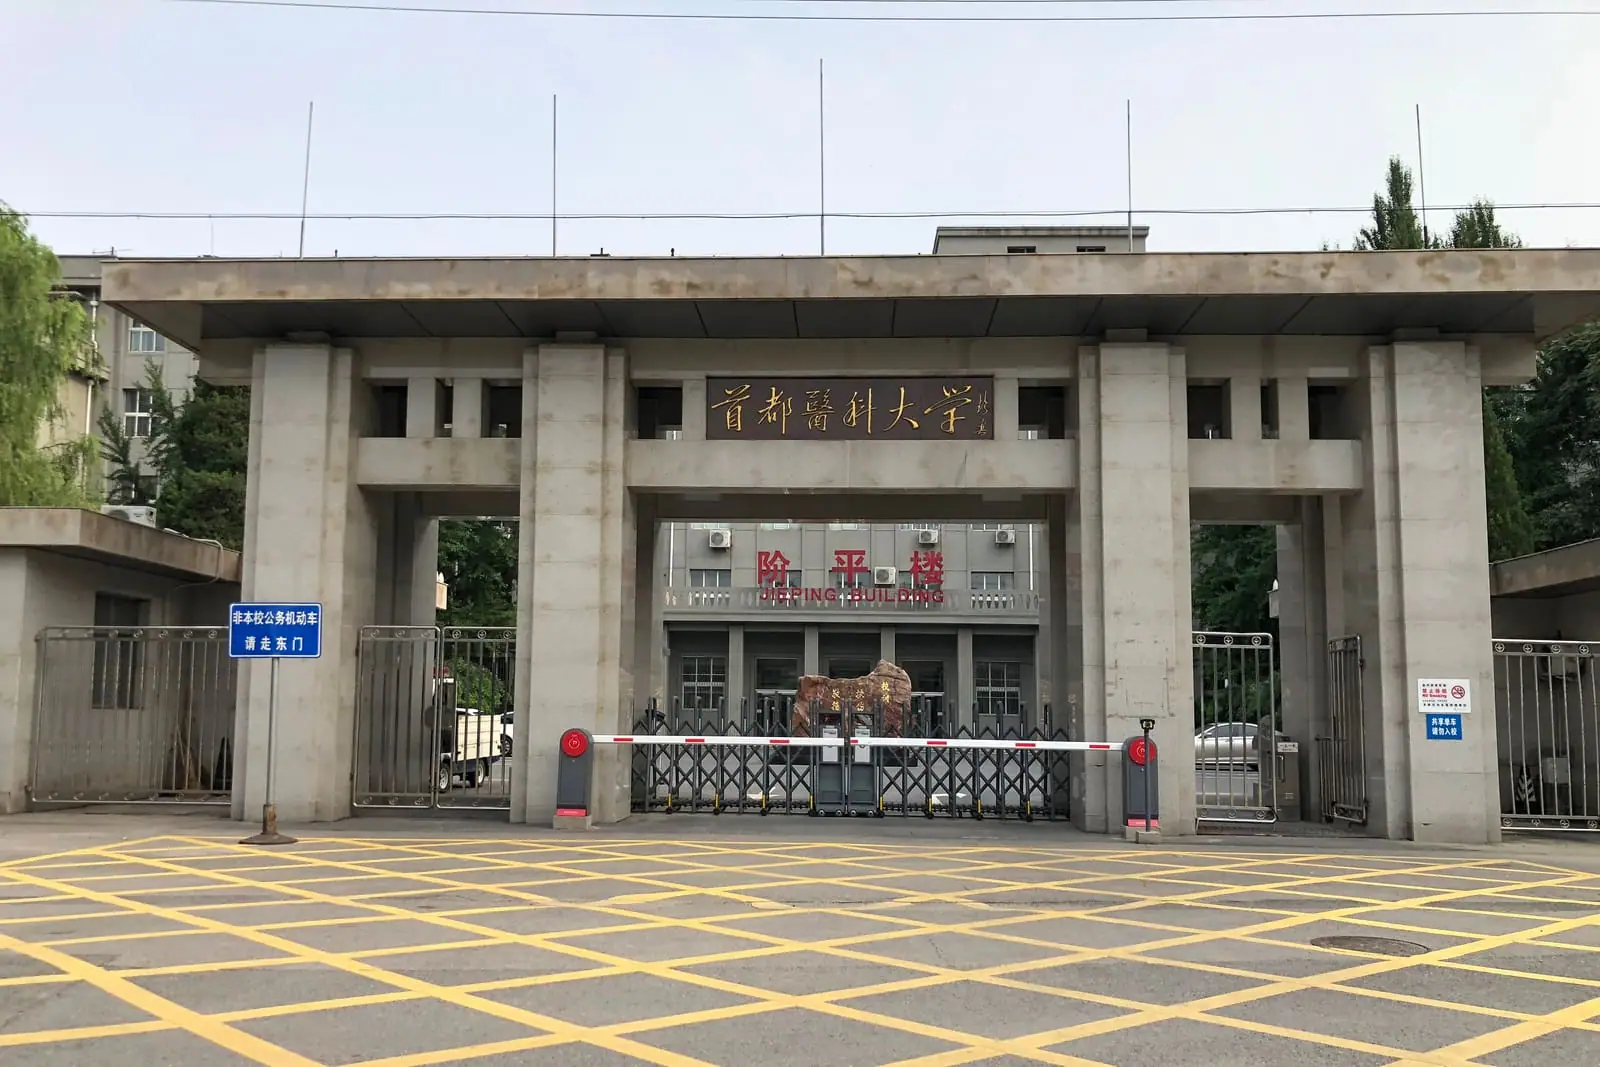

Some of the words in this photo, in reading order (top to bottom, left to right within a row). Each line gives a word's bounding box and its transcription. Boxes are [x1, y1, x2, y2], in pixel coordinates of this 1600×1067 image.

[757, 549, 944, 585] 阶平楼
[759, 587, 838, 603] JIEPING
[851, 587, 945, 603] BUILDING
[232, 610, 318, 626] 非本校公务机动车
[244, 635, 304, 651] 请走东门
[1431, 717, 1457, 726] 共享单车
[1432, 727, 1457, 736] 请勿入校
